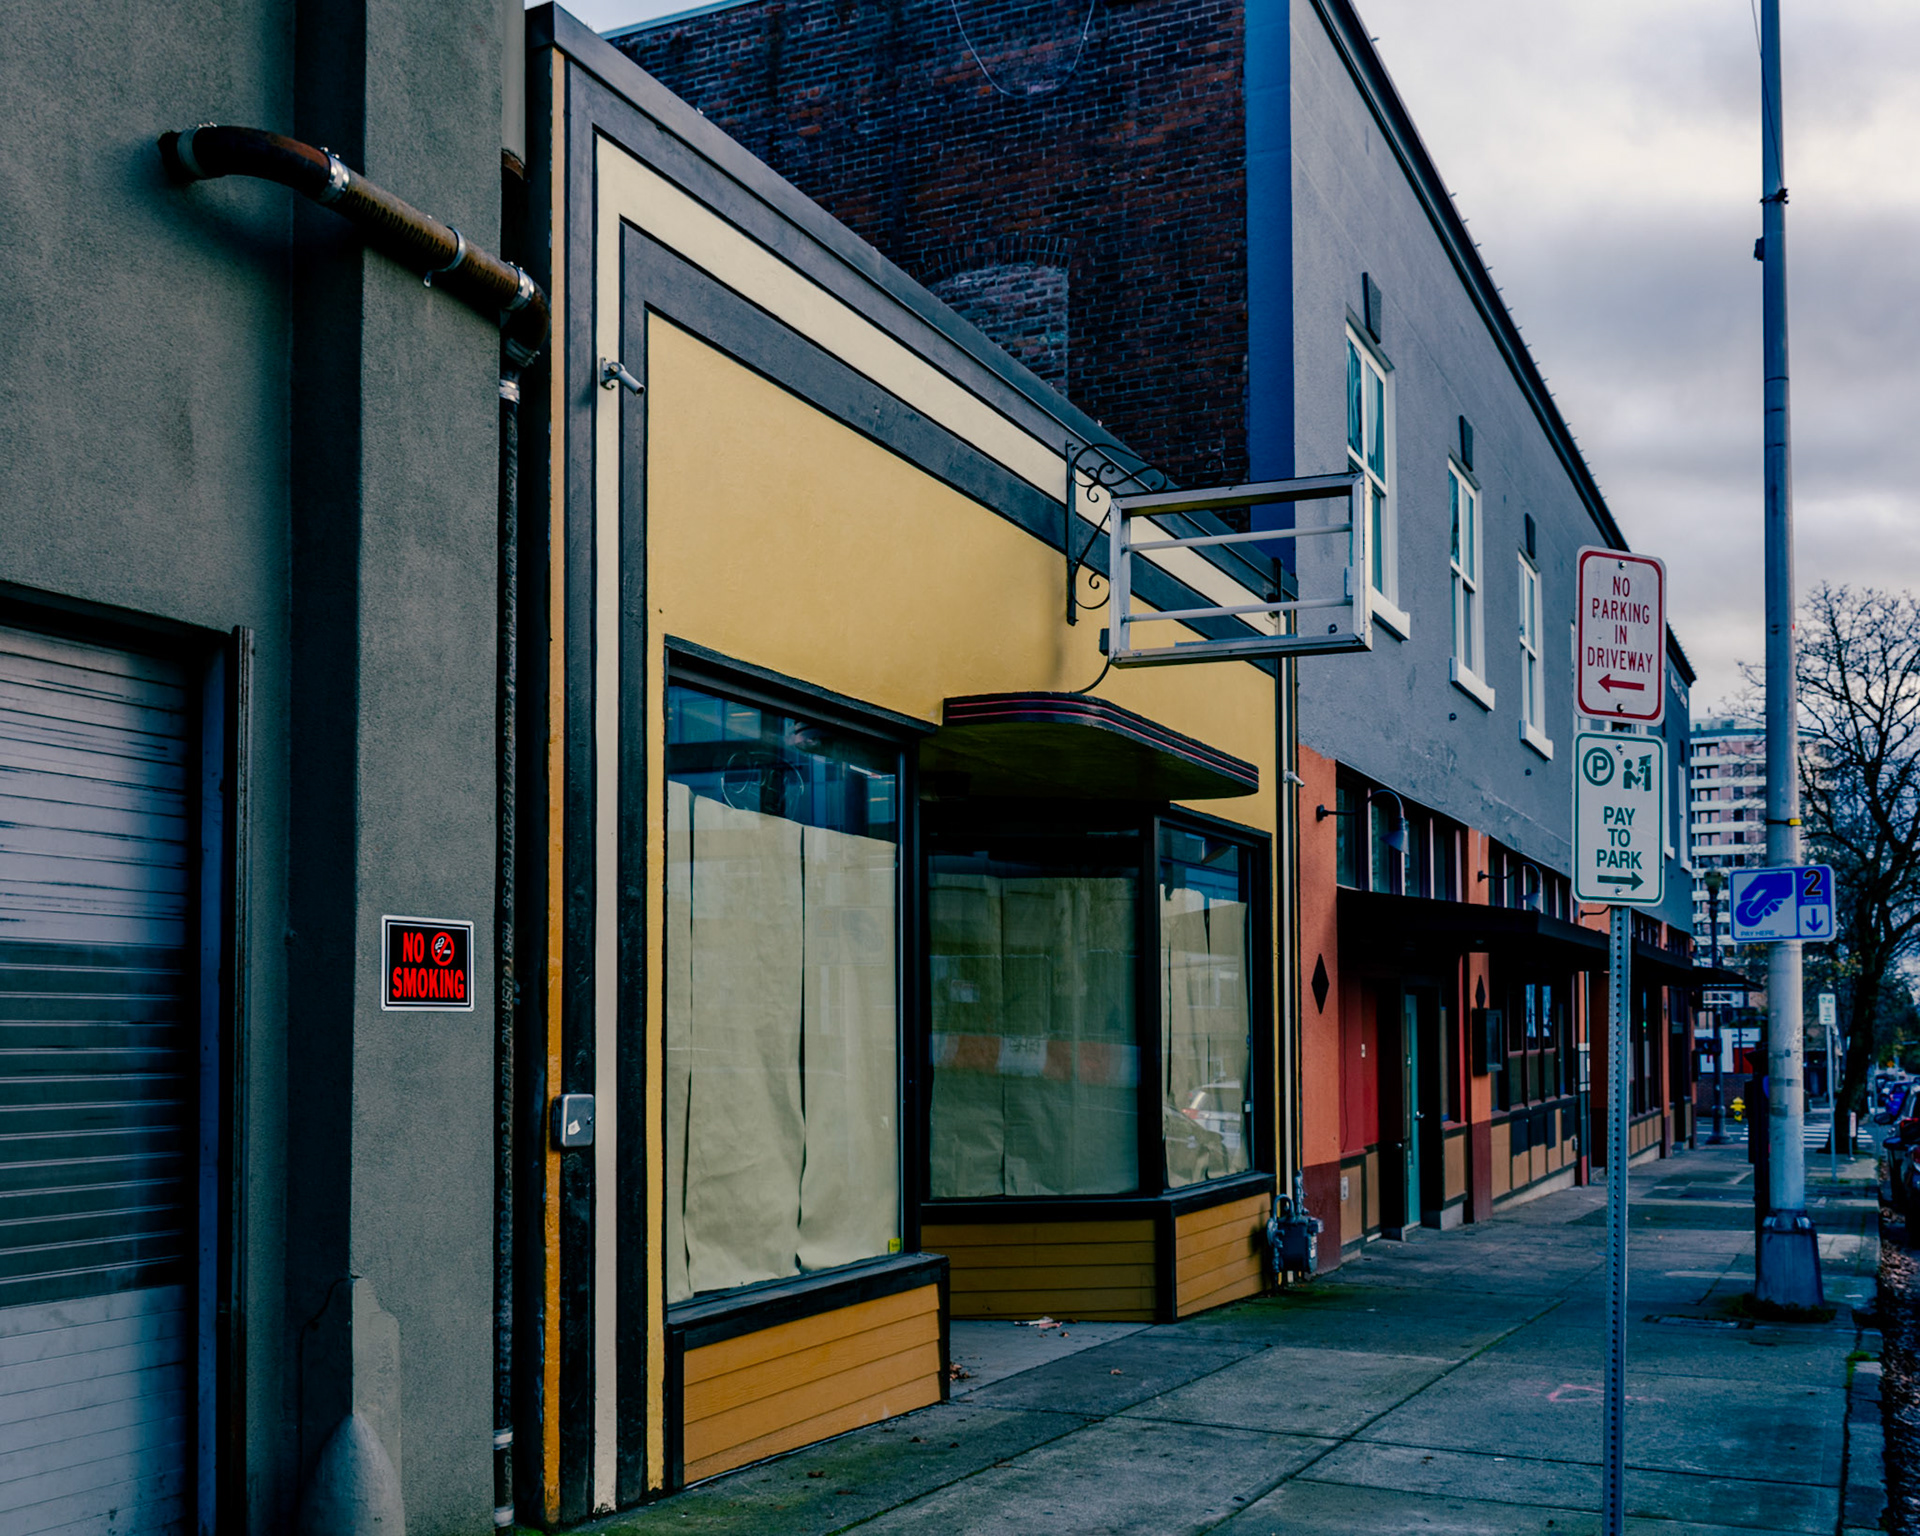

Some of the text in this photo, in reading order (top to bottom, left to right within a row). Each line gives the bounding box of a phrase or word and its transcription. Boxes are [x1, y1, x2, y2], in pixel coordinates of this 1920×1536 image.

[1613, 576, 1630, 597] NO
[1592, 598, 1650, 624] PARKING
[1615, 625, 1627, 645] IN
[1587, 646, 1653, 673] DRIVEWAY
[1603, 806, 1635, 825] PAY
[1607, 828, 1631, 847] TO
[1596, 849, 1642, 869] PARK
[1803, 869, 1822, 896] 2
[402, 932, 425, 963] NO
[392, 966, 465, 999] SMOKING
